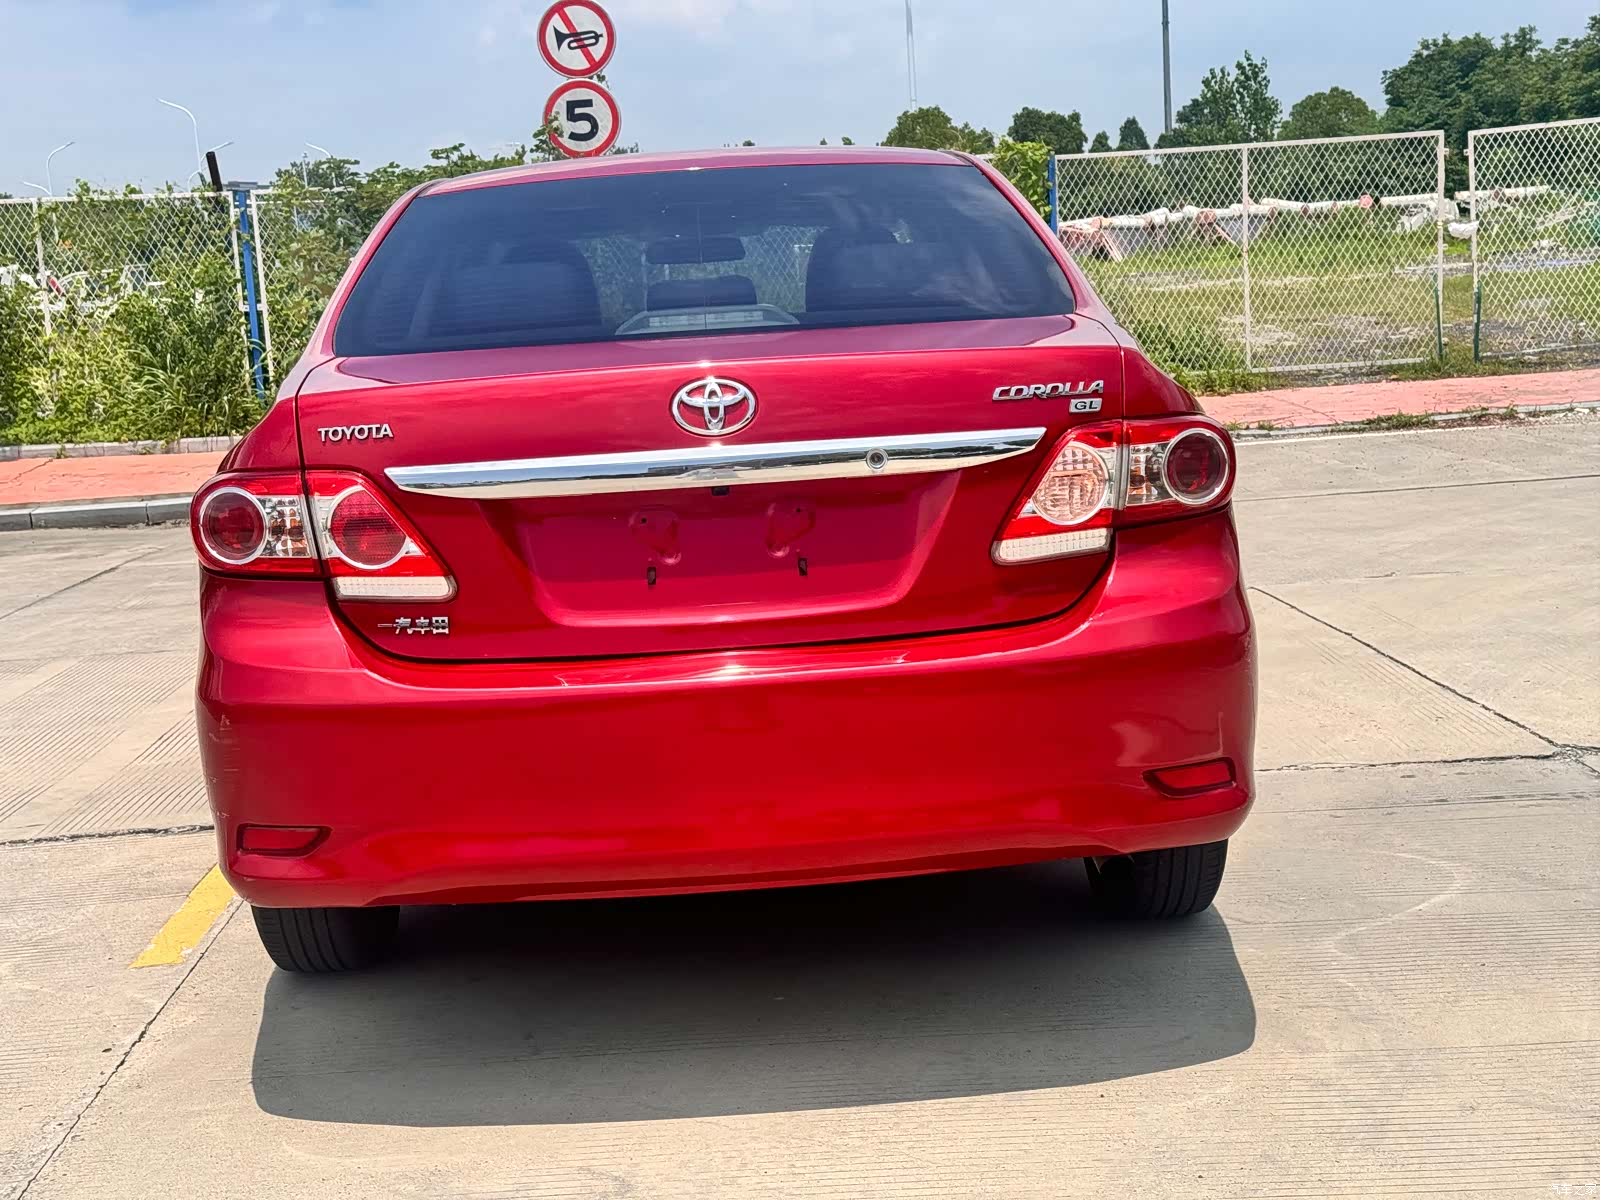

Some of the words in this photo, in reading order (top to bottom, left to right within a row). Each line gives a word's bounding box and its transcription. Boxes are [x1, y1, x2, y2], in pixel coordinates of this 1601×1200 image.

[566, 99, 599, 142] 5
[992, 380, 1104, 400] COROLLA
[1074, 400, 1098, 410] GL
[317, 423, 394, 442] TOYOTA
[377, 616, 449, 635] 一汽丰田
